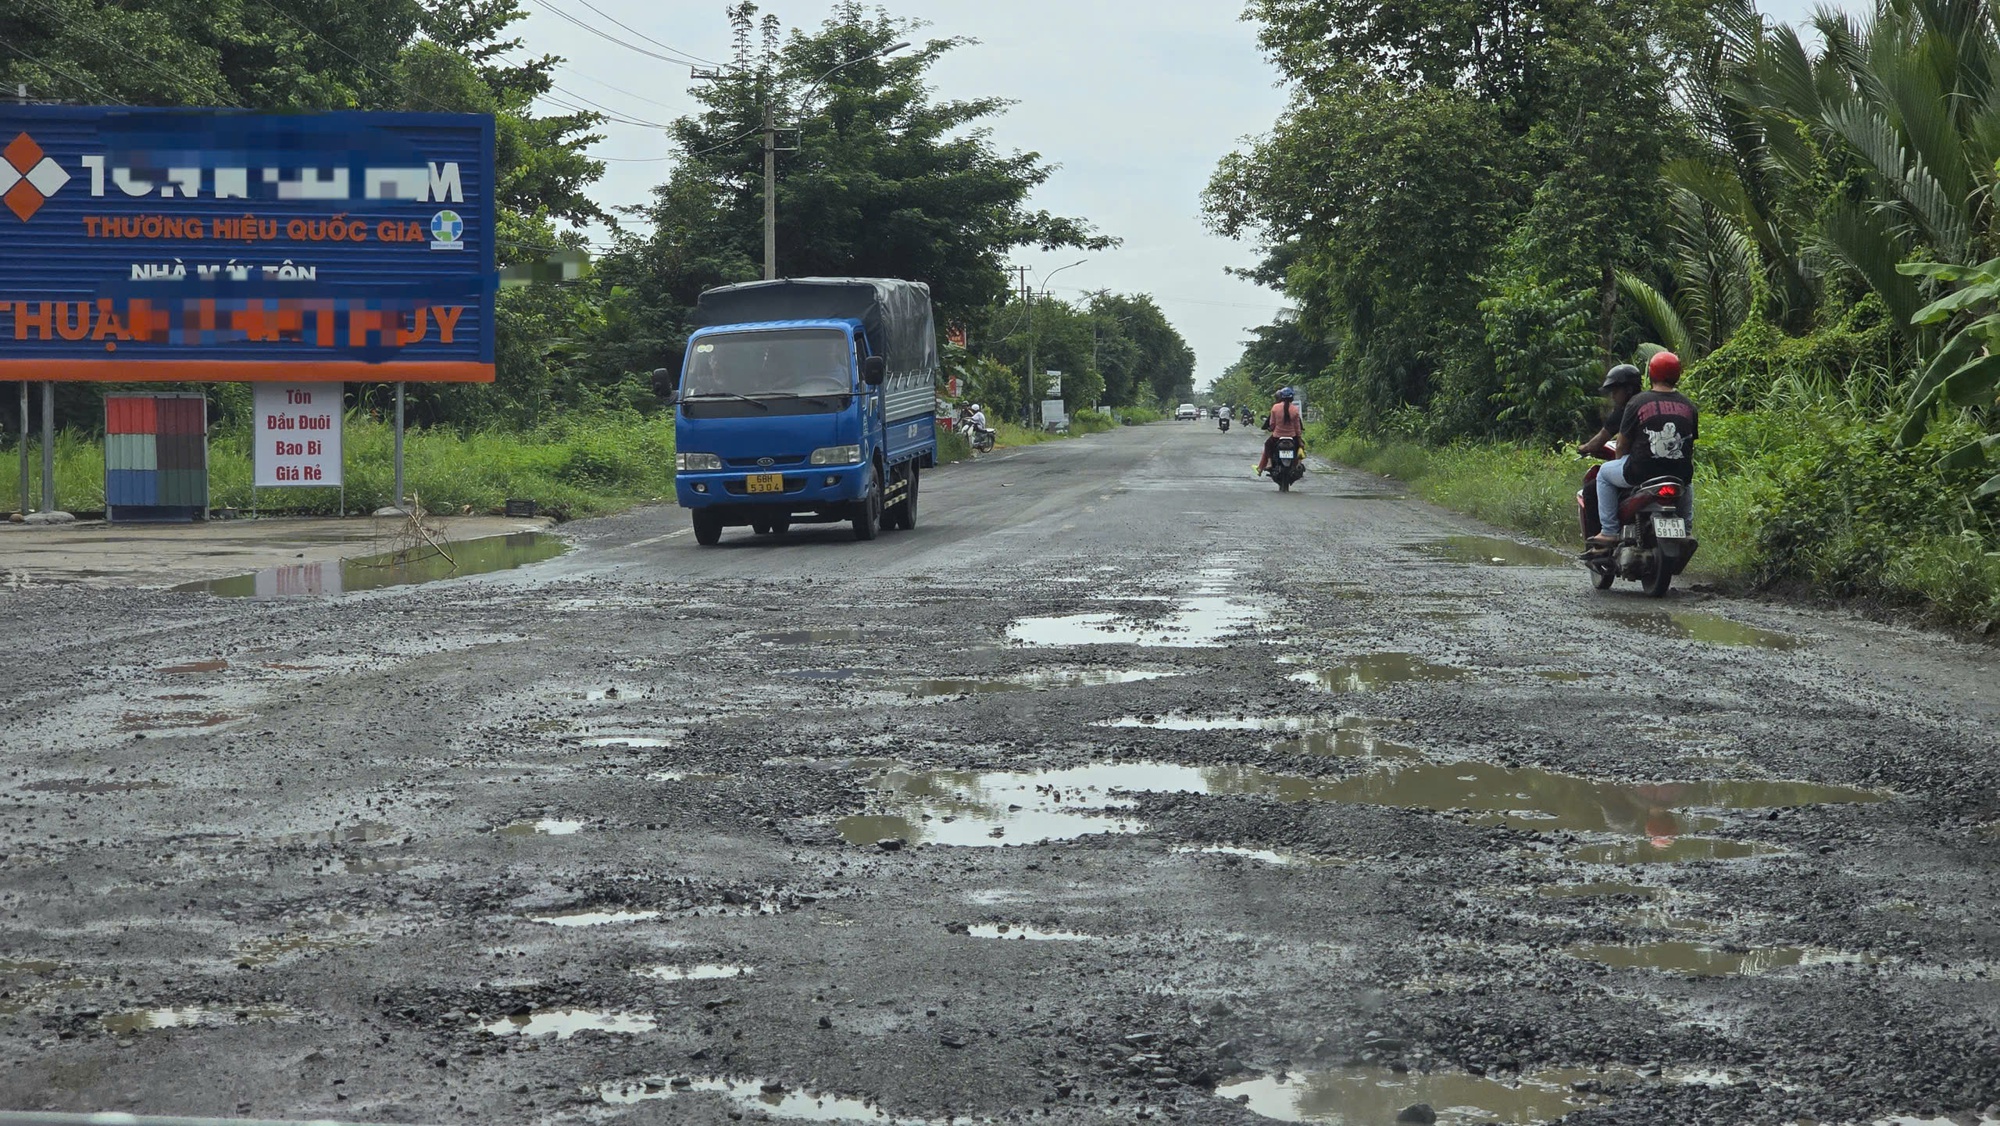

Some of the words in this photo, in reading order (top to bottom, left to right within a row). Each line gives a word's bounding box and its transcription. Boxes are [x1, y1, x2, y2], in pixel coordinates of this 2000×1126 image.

[82, 213, 204, 239] THƯƠNG
[212, 213, 278, 244] HIỆU
[286, 211, 368, 242] QUỐC
[376, 220, 426, 243] GIA
[286, 389, 313, 405] Tôn
[267, 412, 295, 430] Đầu
[298, 414, 331, 430] Đuôi
[276, 441, 303, 456] Bao
[276, 466, 300, 481] Giá
[303, 464, 322, 481] Rẻ
[750, 483, 779, 491] 5304
